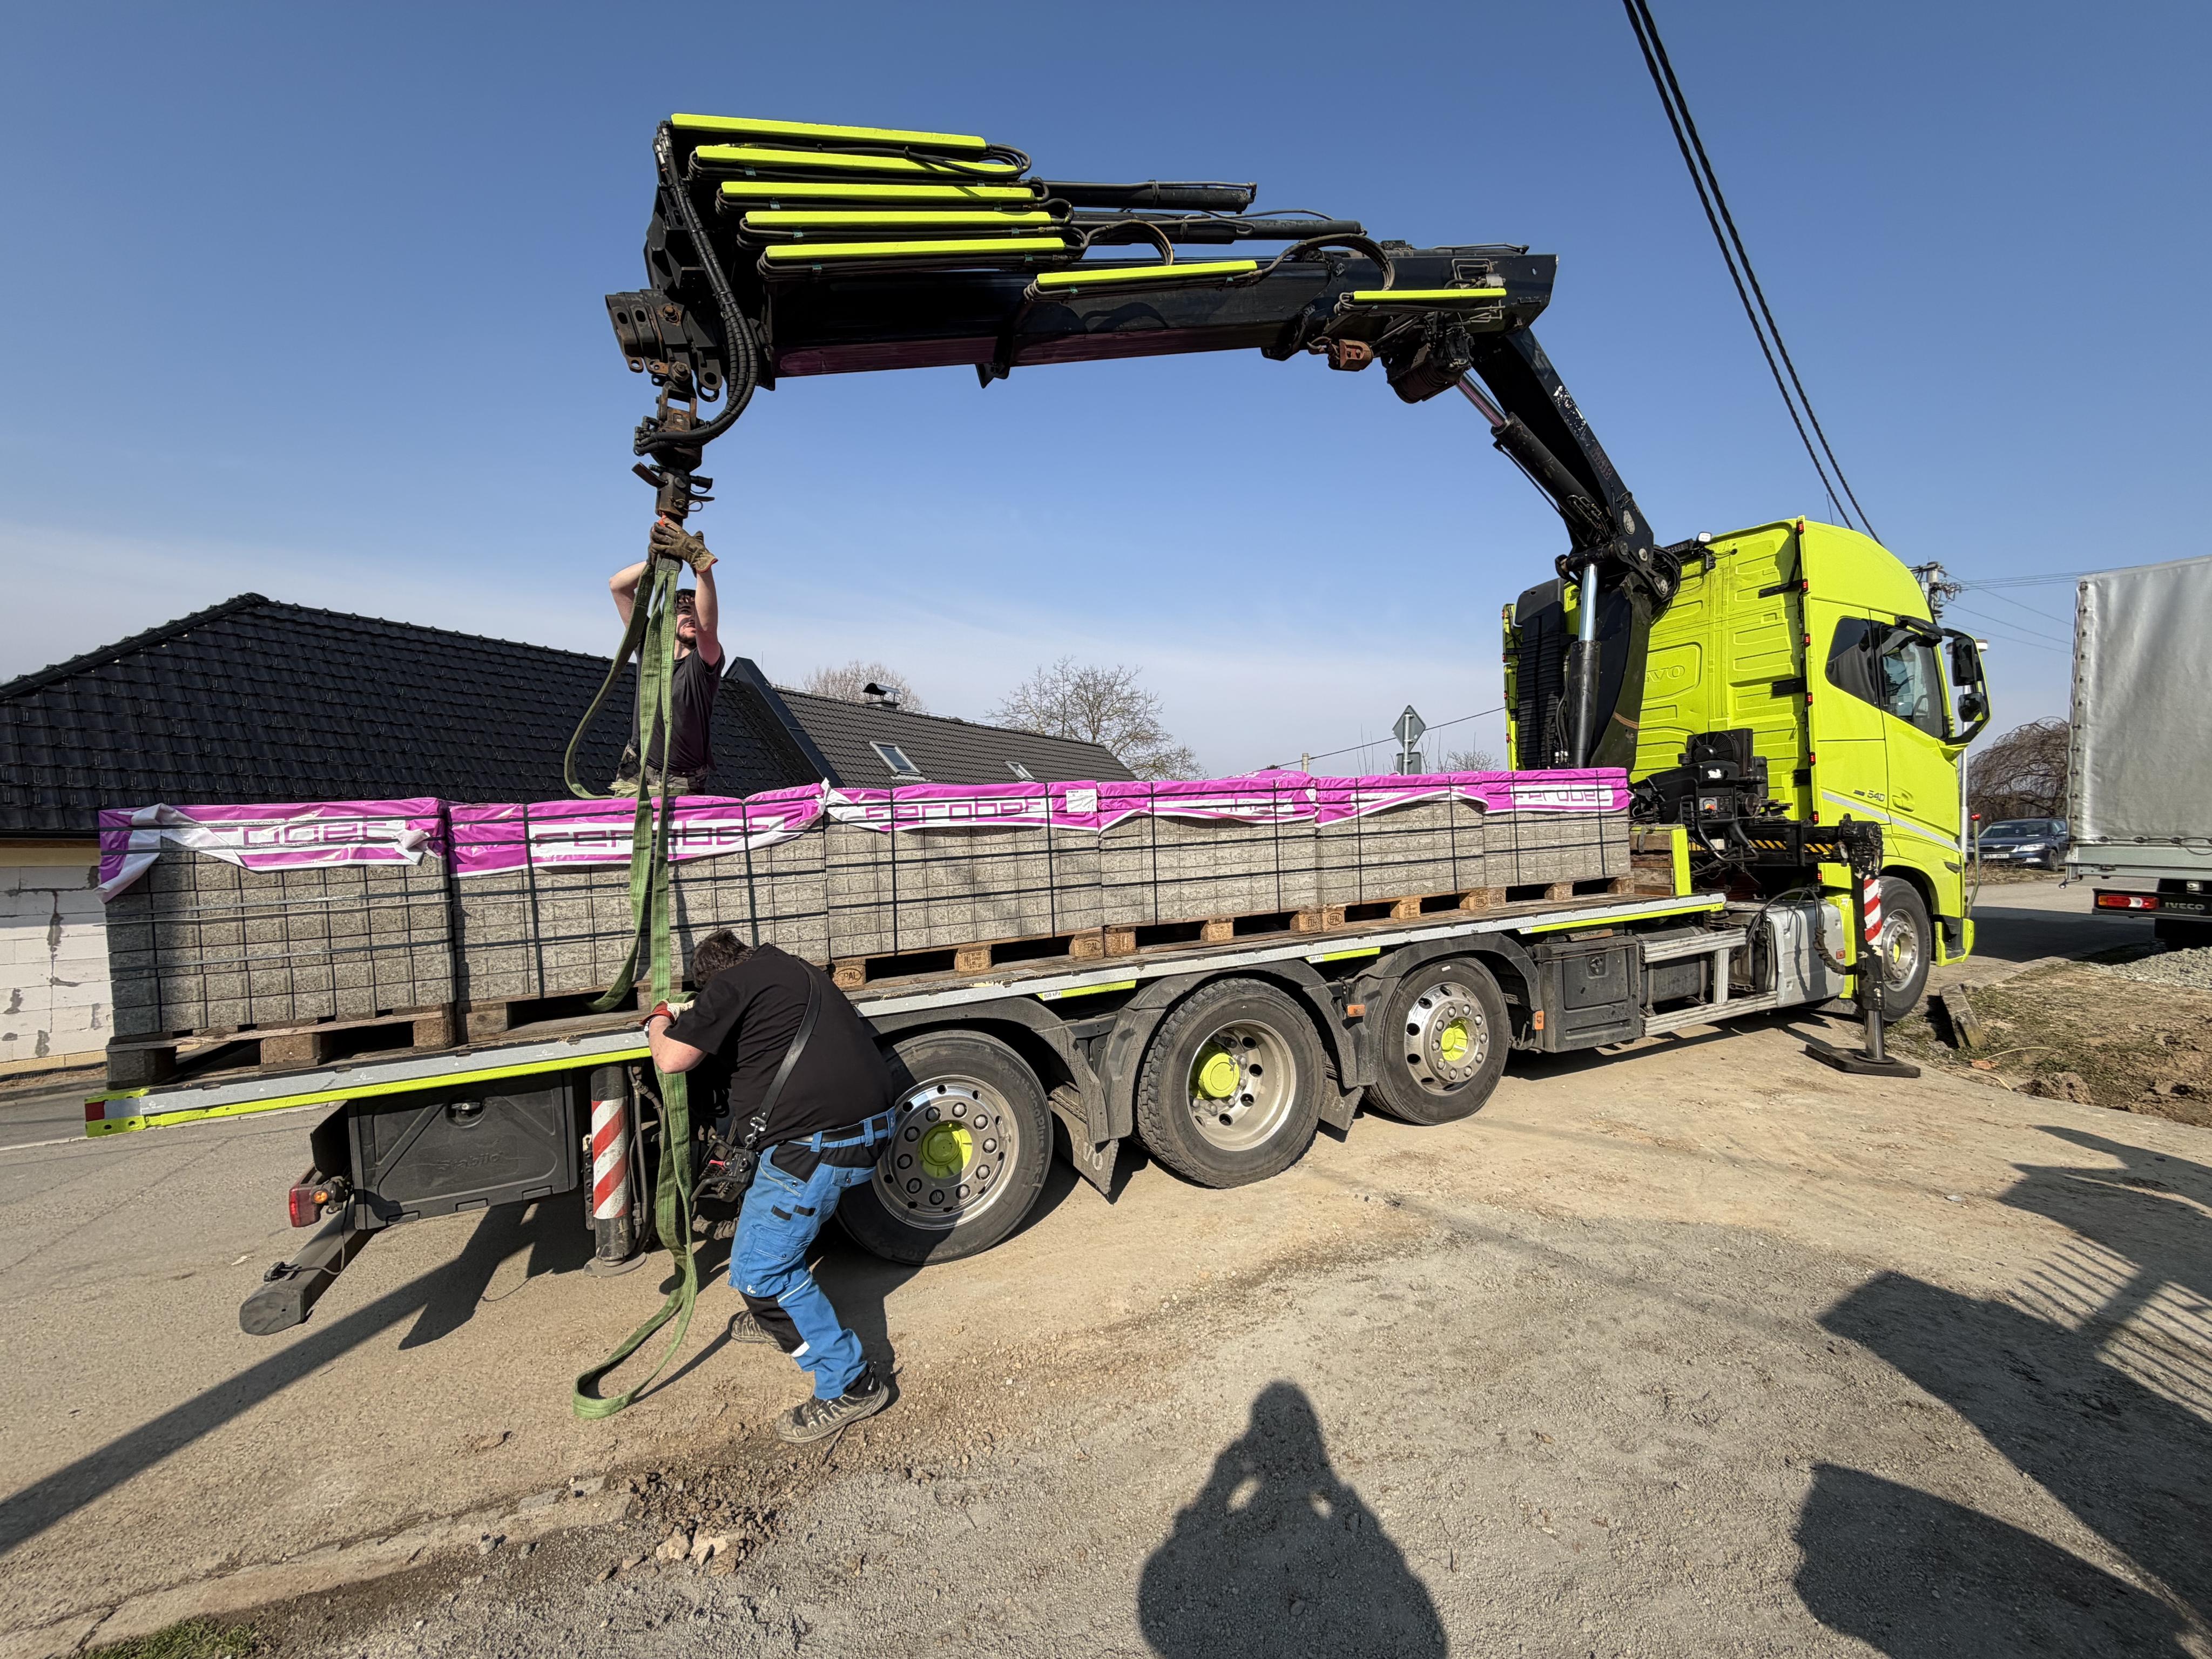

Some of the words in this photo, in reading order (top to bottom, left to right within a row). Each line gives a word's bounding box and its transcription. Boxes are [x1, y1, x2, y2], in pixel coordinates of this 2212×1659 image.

[1867, 790, 1885, 802] 540
[535, 818, 770, 847] ferbet
[2165, 902, 2205, 911] IVECO
[1330, 915, 1340, 923] EPAL
